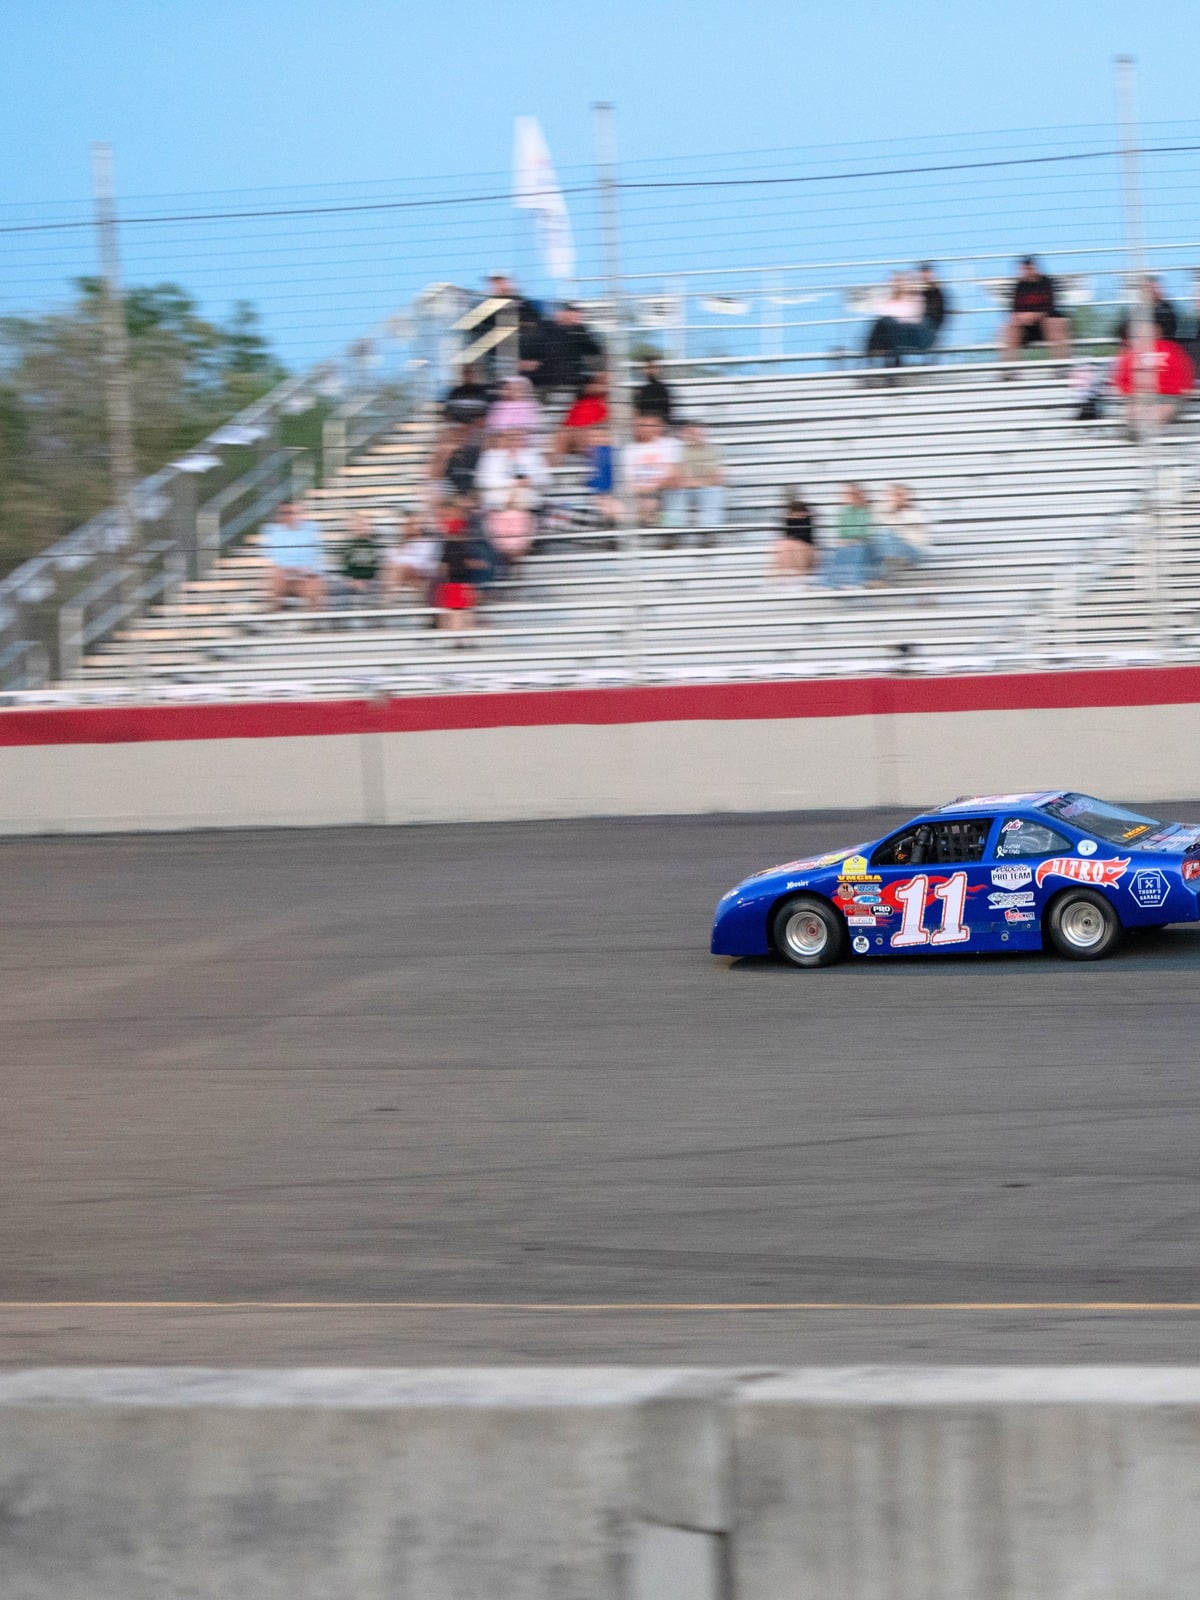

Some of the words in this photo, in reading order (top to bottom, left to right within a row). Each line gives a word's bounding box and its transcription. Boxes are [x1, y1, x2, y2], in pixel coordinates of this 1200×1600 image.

[992, 873, 1008, 881] PRO
[1010, 871, 1031, 880] TEAM
[786, 880, 809, 889] Hoosier
[890, 871, 970, 948] 11
